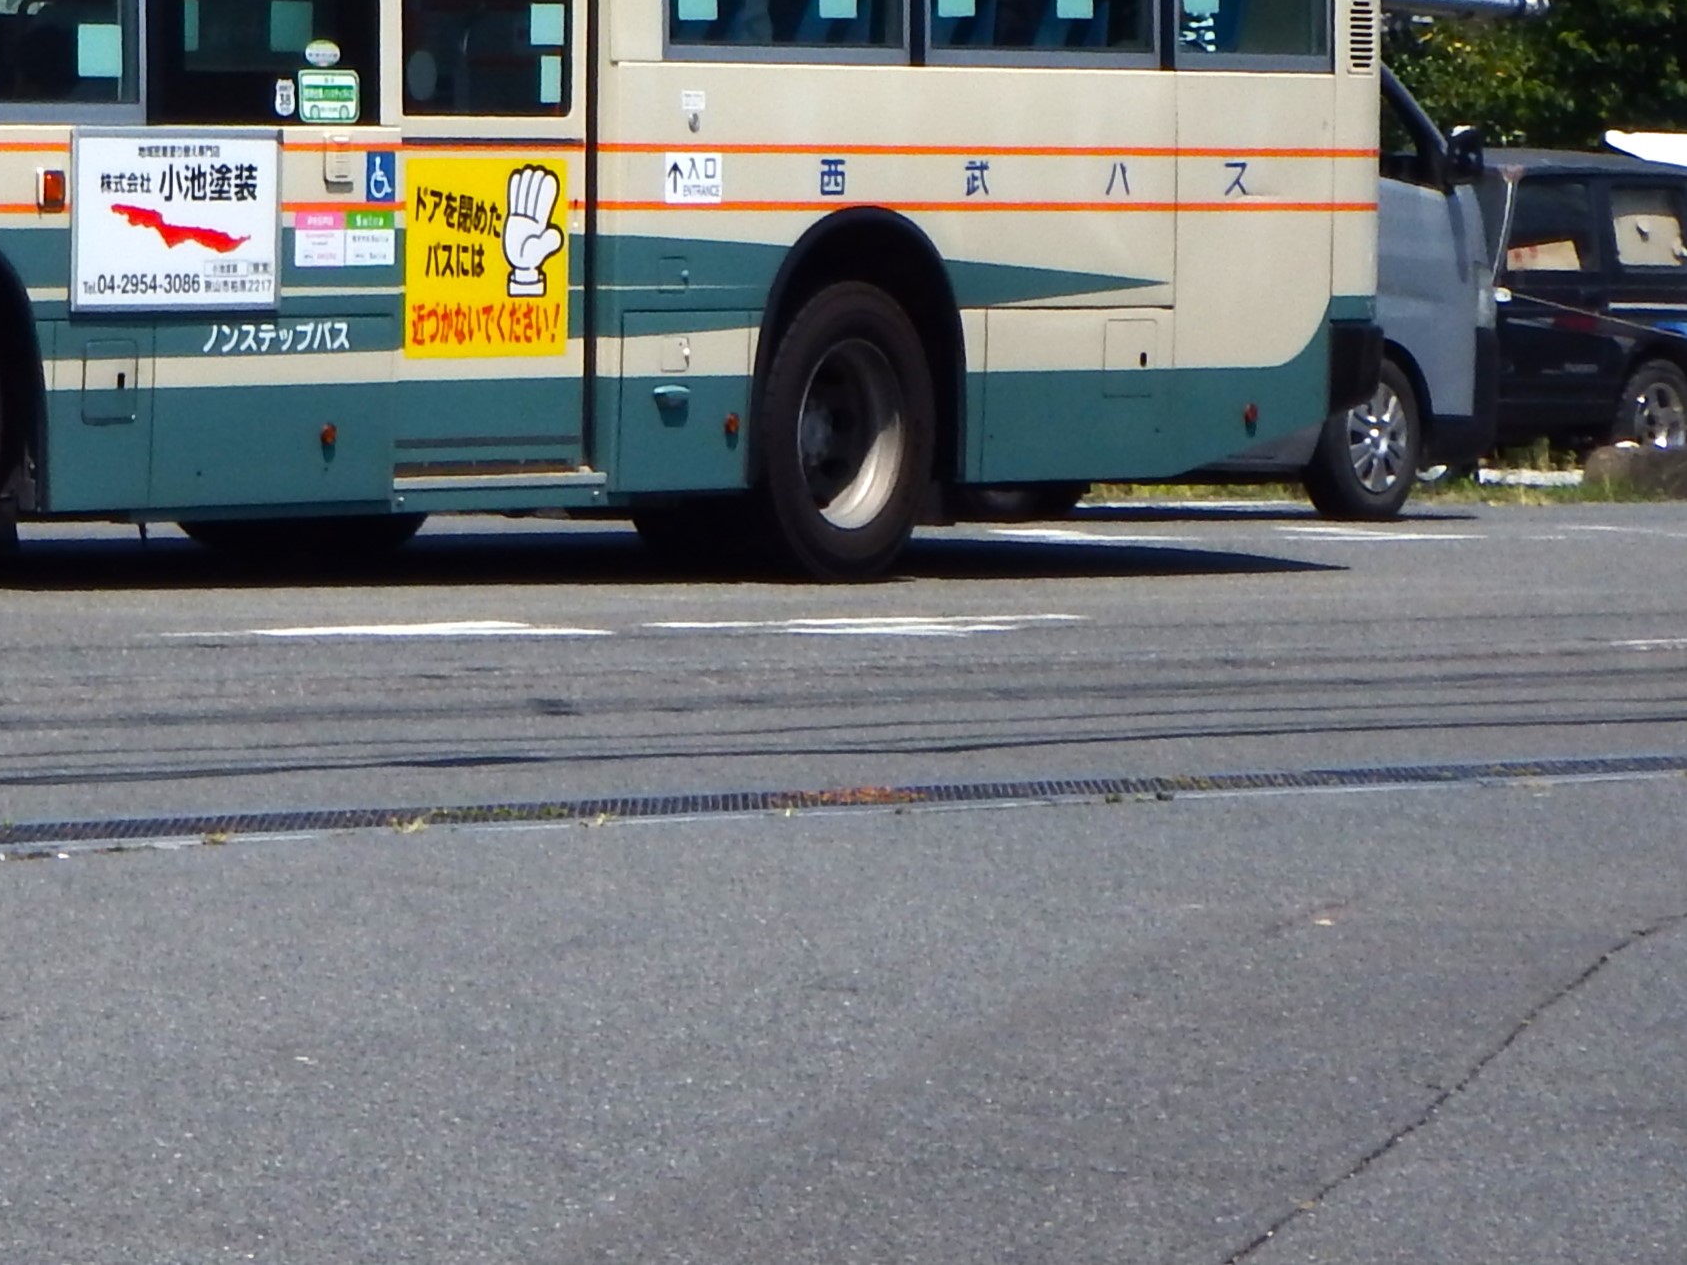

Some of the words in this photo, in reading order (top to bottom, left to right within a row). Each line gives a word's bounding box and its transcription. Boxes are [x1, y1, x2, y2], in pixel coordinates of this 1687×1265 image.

[100, 172, 152, 194] 株式会社
[158, 163, 258, 201] 小池塗装
[687, 157, 717, 180] 入口
[682, 184, 720, 197] ENTRANCE
[415, 186, 503, 239] ドアを閉めた
[425, 241, 485, 278] バスには
[203, 322, 350, 353] ノンステップバス
